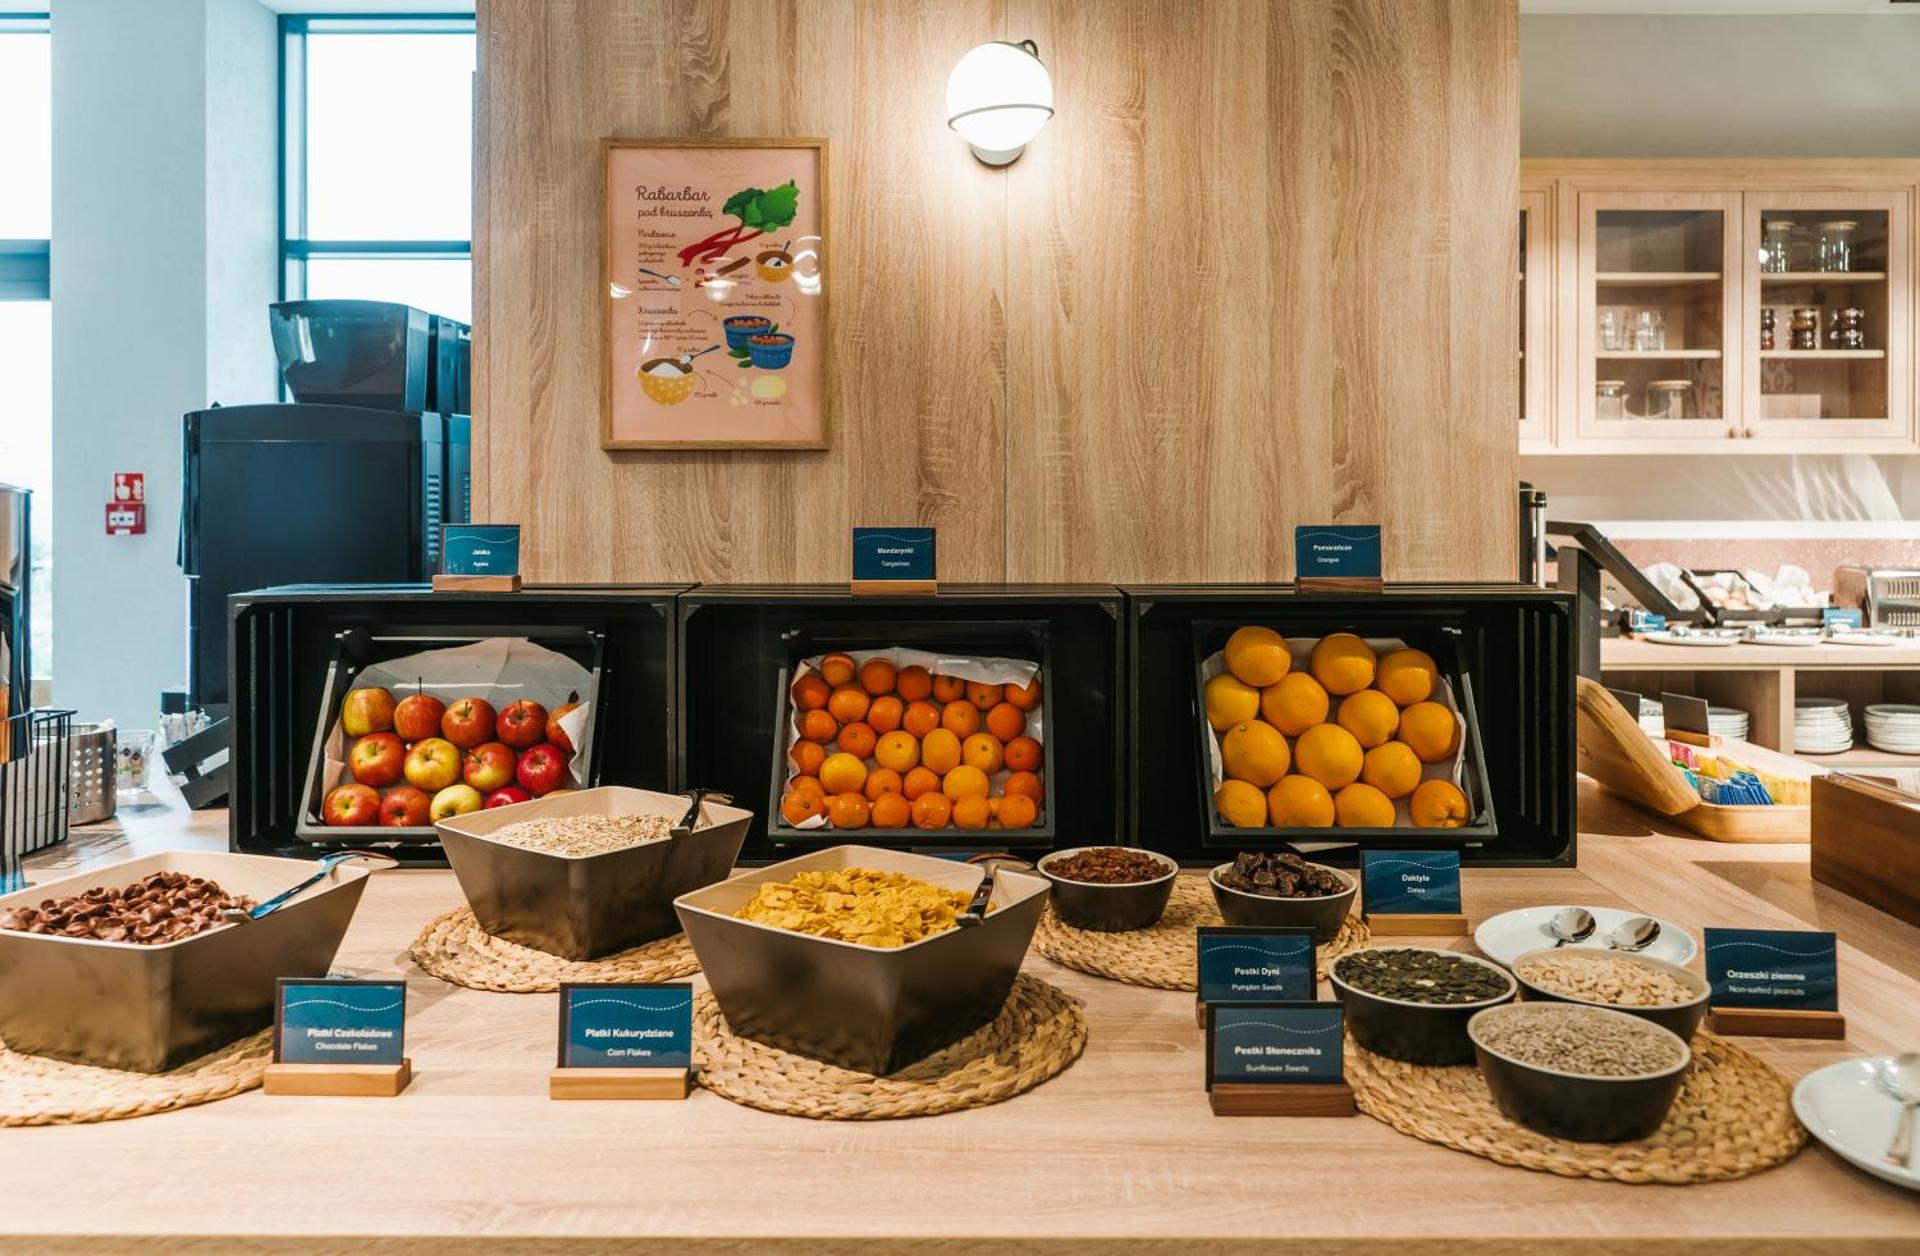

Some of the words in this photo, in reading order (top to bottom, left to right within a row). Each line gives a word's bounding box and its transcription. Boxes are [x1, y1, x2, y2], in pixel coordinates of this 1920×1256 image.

[635, 185, 711, 201] Rabarbar
[638, 206, 659, 219] pod
[1401, 873, 1431, 883] Daktyle
[1407, 886, 1426, 894] Dates
[1234, 967, 1260, 976] Pestki
[1261, 967, 1281, 977] Dyni
[1726, 969, 1770, 980] Orzeszki
[1770, 970, 1806, 981] ziemne
[1231, 983, 1261, 992] Pumpkin
[1261, 983, 1284, 991] Seeds
[612, 1028, 674, 1039] Kukurydziane
[606, 1048, 626, 1057] Corn
[626, 1048, 652, 1057] Flakes
[1234, 1045, 1264, 1056] Pestki
[1245, 1063, 1283, 1073] Sunflower
[1284, 1063, 1310, 1073] Seeds
